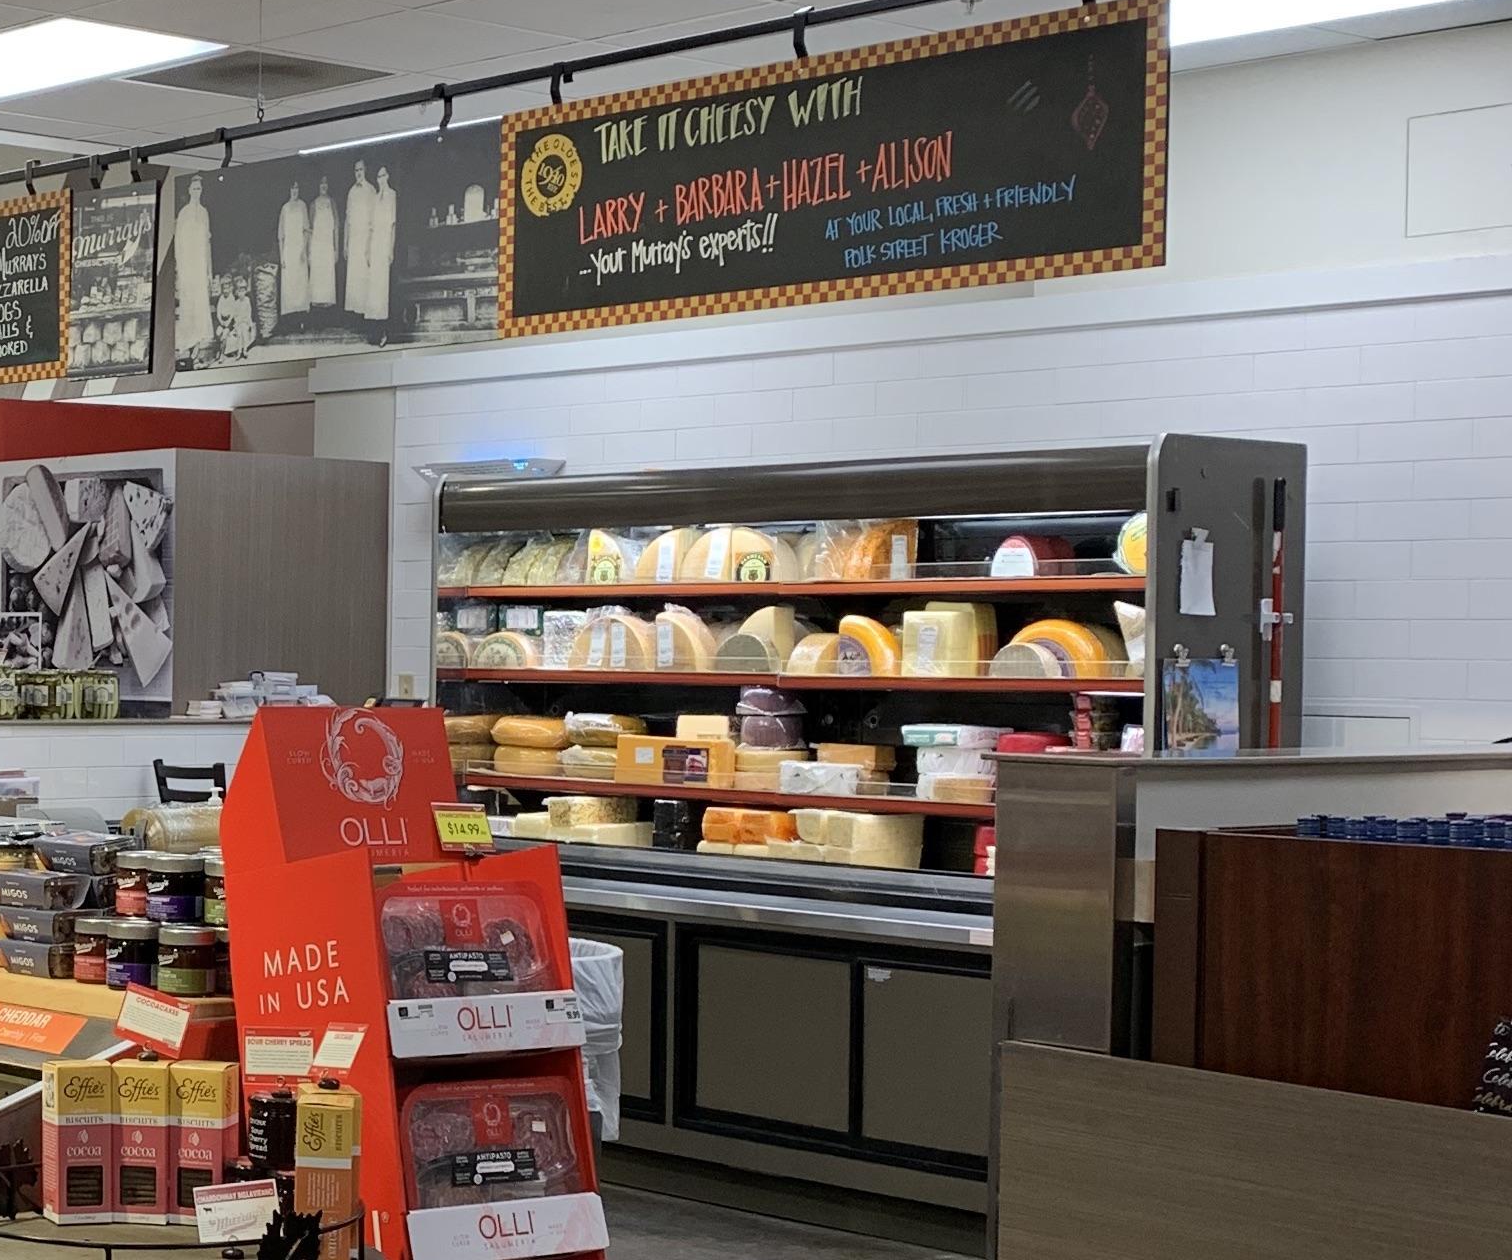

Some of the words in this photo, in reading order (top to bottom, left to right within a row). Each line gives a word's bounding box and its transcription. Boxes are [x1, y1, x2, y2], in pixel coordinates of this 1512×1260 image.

[594, 114, 648, 164] TAKE
[658, 107, 682, 151] IT
[684, 96, 775, 147] CHEESY
[789, 76, 864, 128] WITH
[538, 162, 564, 187] 1940
[579, 192, 645, 244] LARRY
[675, 167, 764, 225] BARBARA
[782, 152, 851, 212] HAZEL
[872, 130, 953, 192] ALISON
[825, 218, 841, 241] AT
[846, 207, 883, 237] YOUR
[888, 199, 934, 227] LOCAL,
[936, 192, 978, 218] FRESH
[996, 174, 1077, 208] FRIENDLY
[73, 208, 152, 265] Murray's
[631, 230, 691, 274] Murray's
[700, 212, 779, 267] experts!!
[845, 247, 877, 268] POLK
[880, 233, 935, 261] STREET
[941, 221, 1004, 254] KROGER
[340, 817, 408, 847] OLLI
[447, 821, 480, 836] $14.99
[263, 940, 340, 980] MADE
[259, 993, 281, 1016] IN
[296, 976, 351, 1010] USA
[457, 1004, 512, 1032] OLLI
[65, 1115, 105, 1124] BISCUITS
[119, 1116, 158, 1125] BISCUITS
[177, 1118, 216, 1127] BISCUITS
[66, 1145, 102, 1157] cocoa
[121, 1145, 156, 1158] cocoa
[178, 1148, 213, 1160] cocoa
[478, 1210, 534, 1240] OLLI
